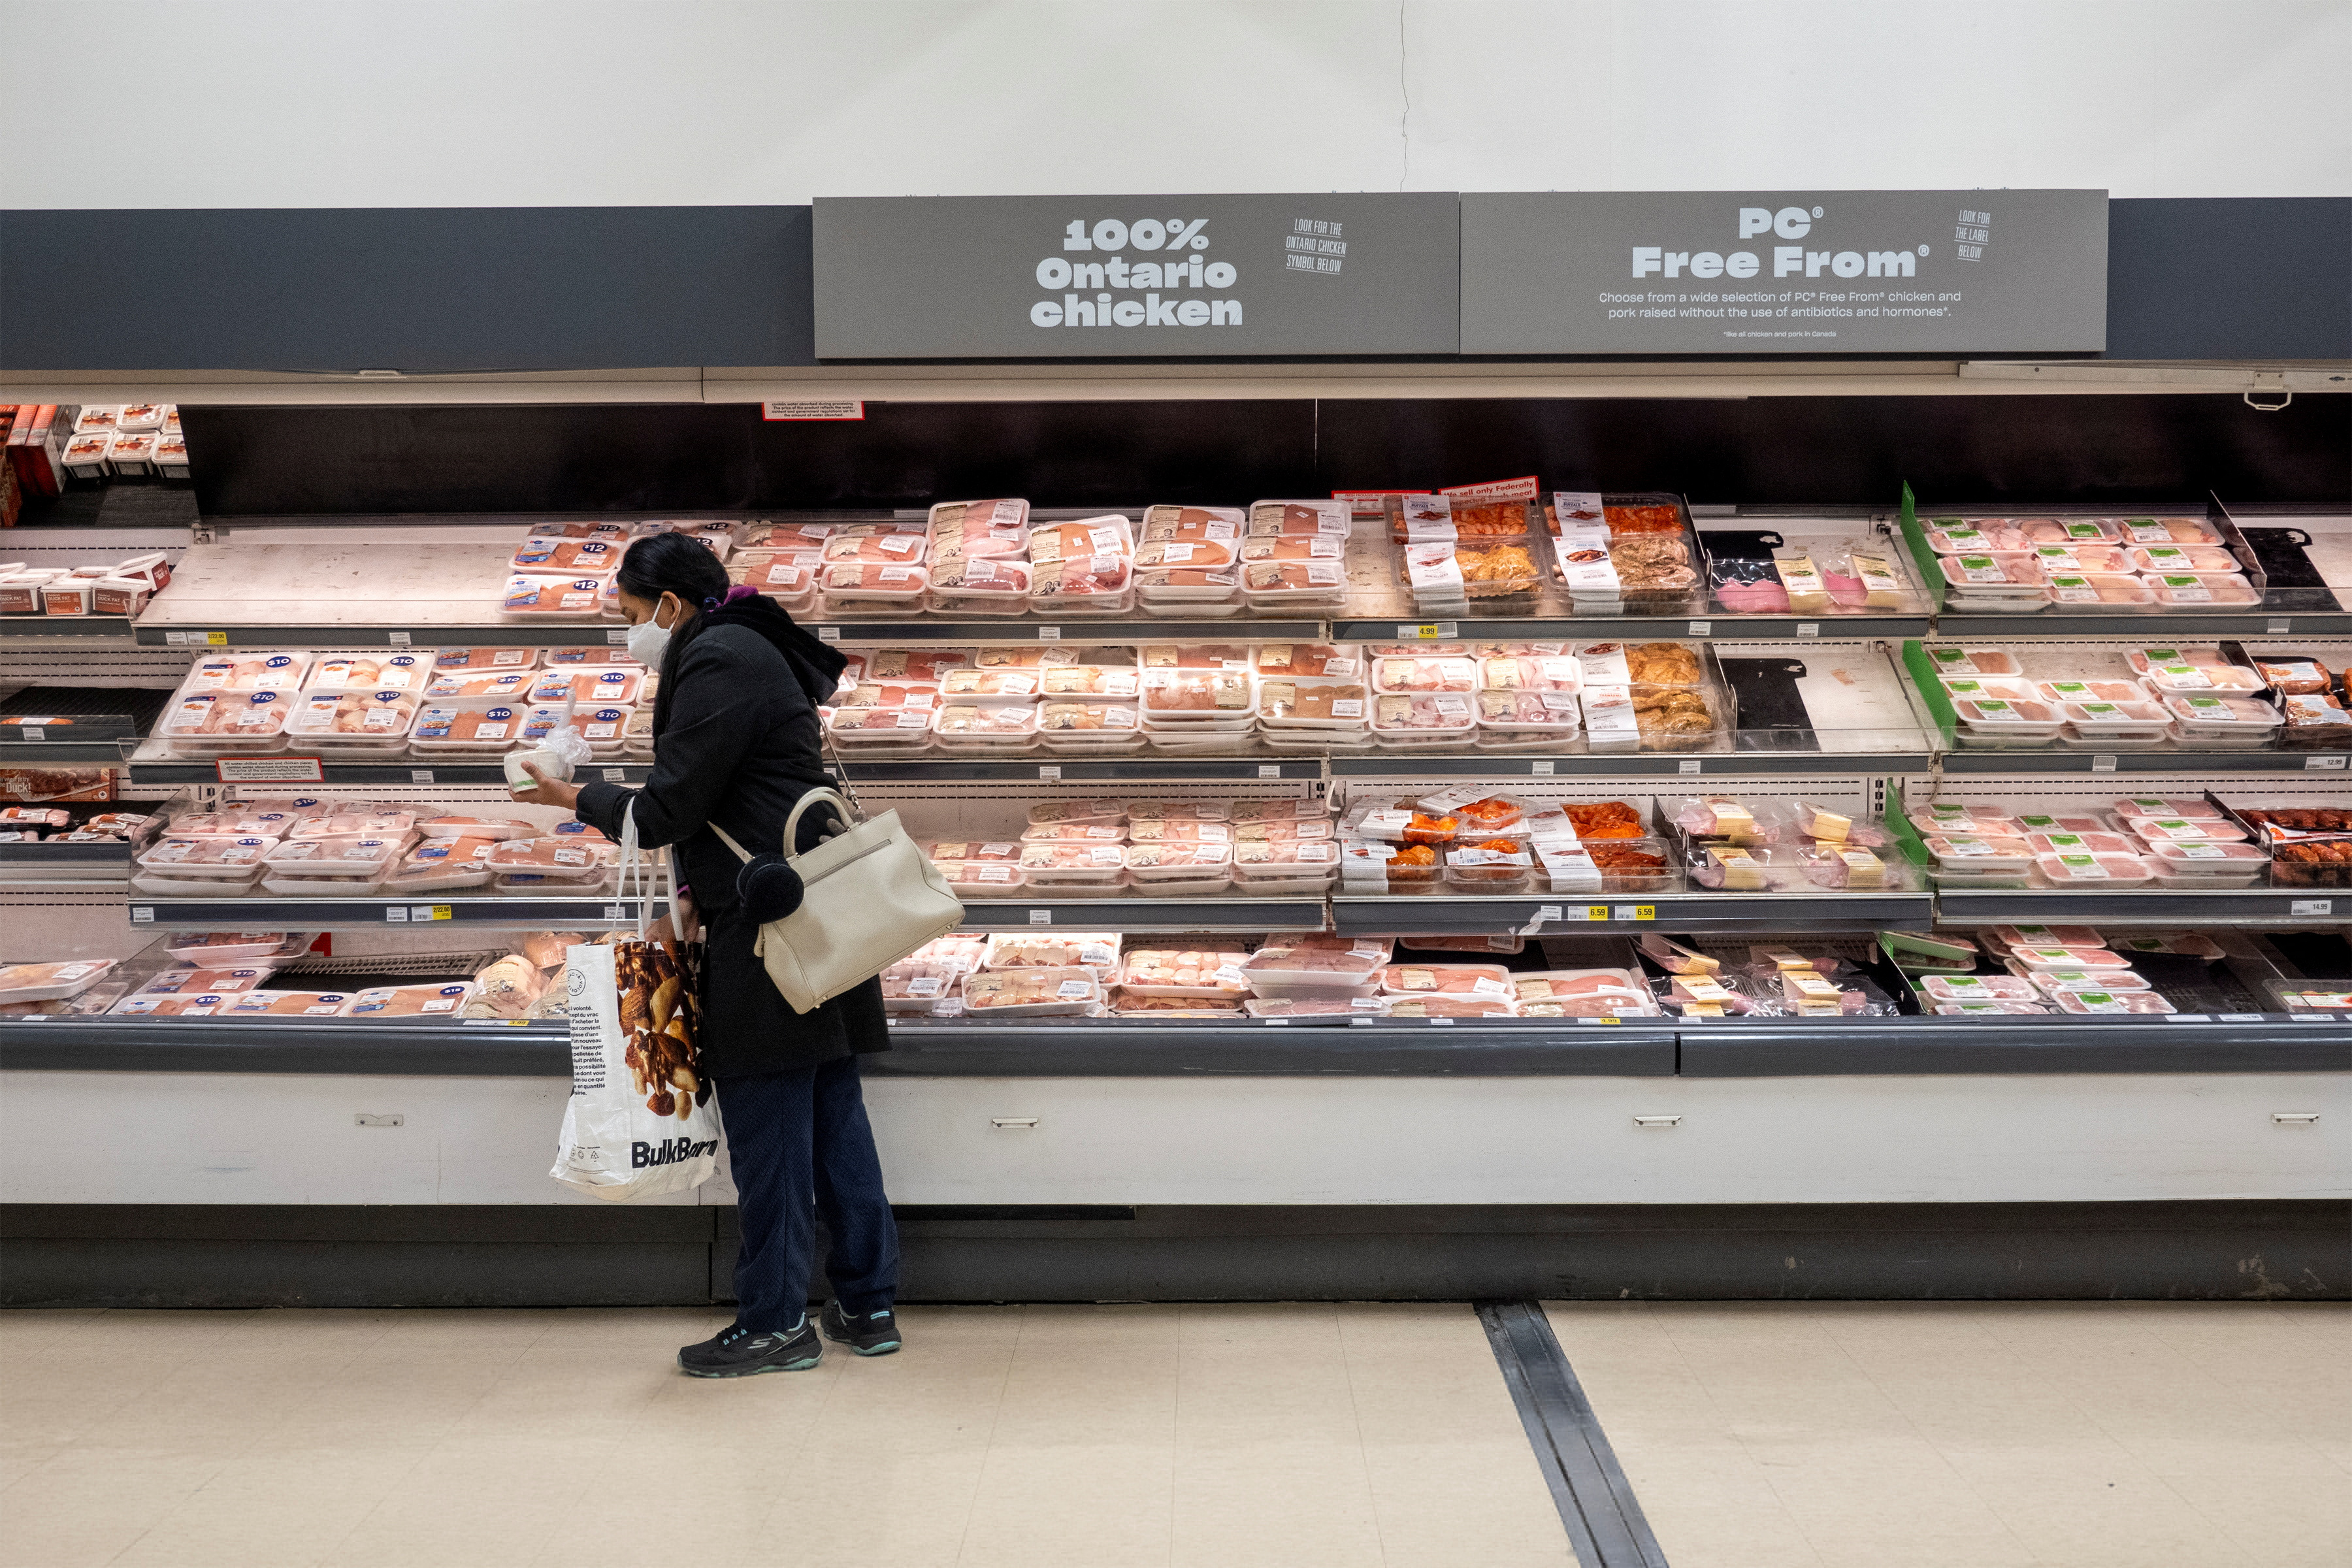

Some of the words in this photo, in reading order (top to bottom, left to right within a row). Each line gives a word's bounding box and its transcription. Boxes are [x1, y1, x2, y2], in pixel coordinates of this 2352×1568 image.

[1959, 210, 1976, 223] LOOK
[1978, 212, 1991, 224] FOR
[1294, 218, 1313, 232] LOOK
[1314, 220, 1328, 234] FOR
[1330, 222, 1343, 235] THE
[1064, 218, 1209, 251] 100%
[1955, 227, 1968, 239] THE
[1968, 229, 1989, 242] LABEL
[1286, 236, 1316, 251] ONTARIO
[1318, 240, 1347, 255] CHICKEN
[1958, 245, 1982, 259] BELOW
[1286, 254, 1315, 269] SYMBOL
[1317, 257, 1342, 272] BELOW
[1632, 246, 1760, 278] Free
[1036, 254, 1237, 289] Ontario
[1599, 292, 1644, 302] Choose
[1647, 292, 1676, 302] from
[1690, 291, 1718, 302] wide
[1722, 291, 1776, 302] selection
[1779, 291, 1791, 302] of
[1820, 292, 1846, 302] Free
[1888, 291, 1935, 301] chicken
[1938, 291, 1961, 301] and
[1030, 293, 1243, 327] chicken
[1609, 307, 1636, 319] pork
[1639, 307, 1676, 318] raised
[1680, 307, 1724, 318] without
[1727, 307, 1747, 318] the
[1751, 309, 1772, 318] use
[1776, 306, 1788, 317] of
[1791, 307, 1853, 317] antibiotics
[1856, 306, 1879, 317] and
[1496, 482, 1533, 491] Federally
[1449, 497, 1486, 506] nspected
[7, 782, 31, 793] Duck!
